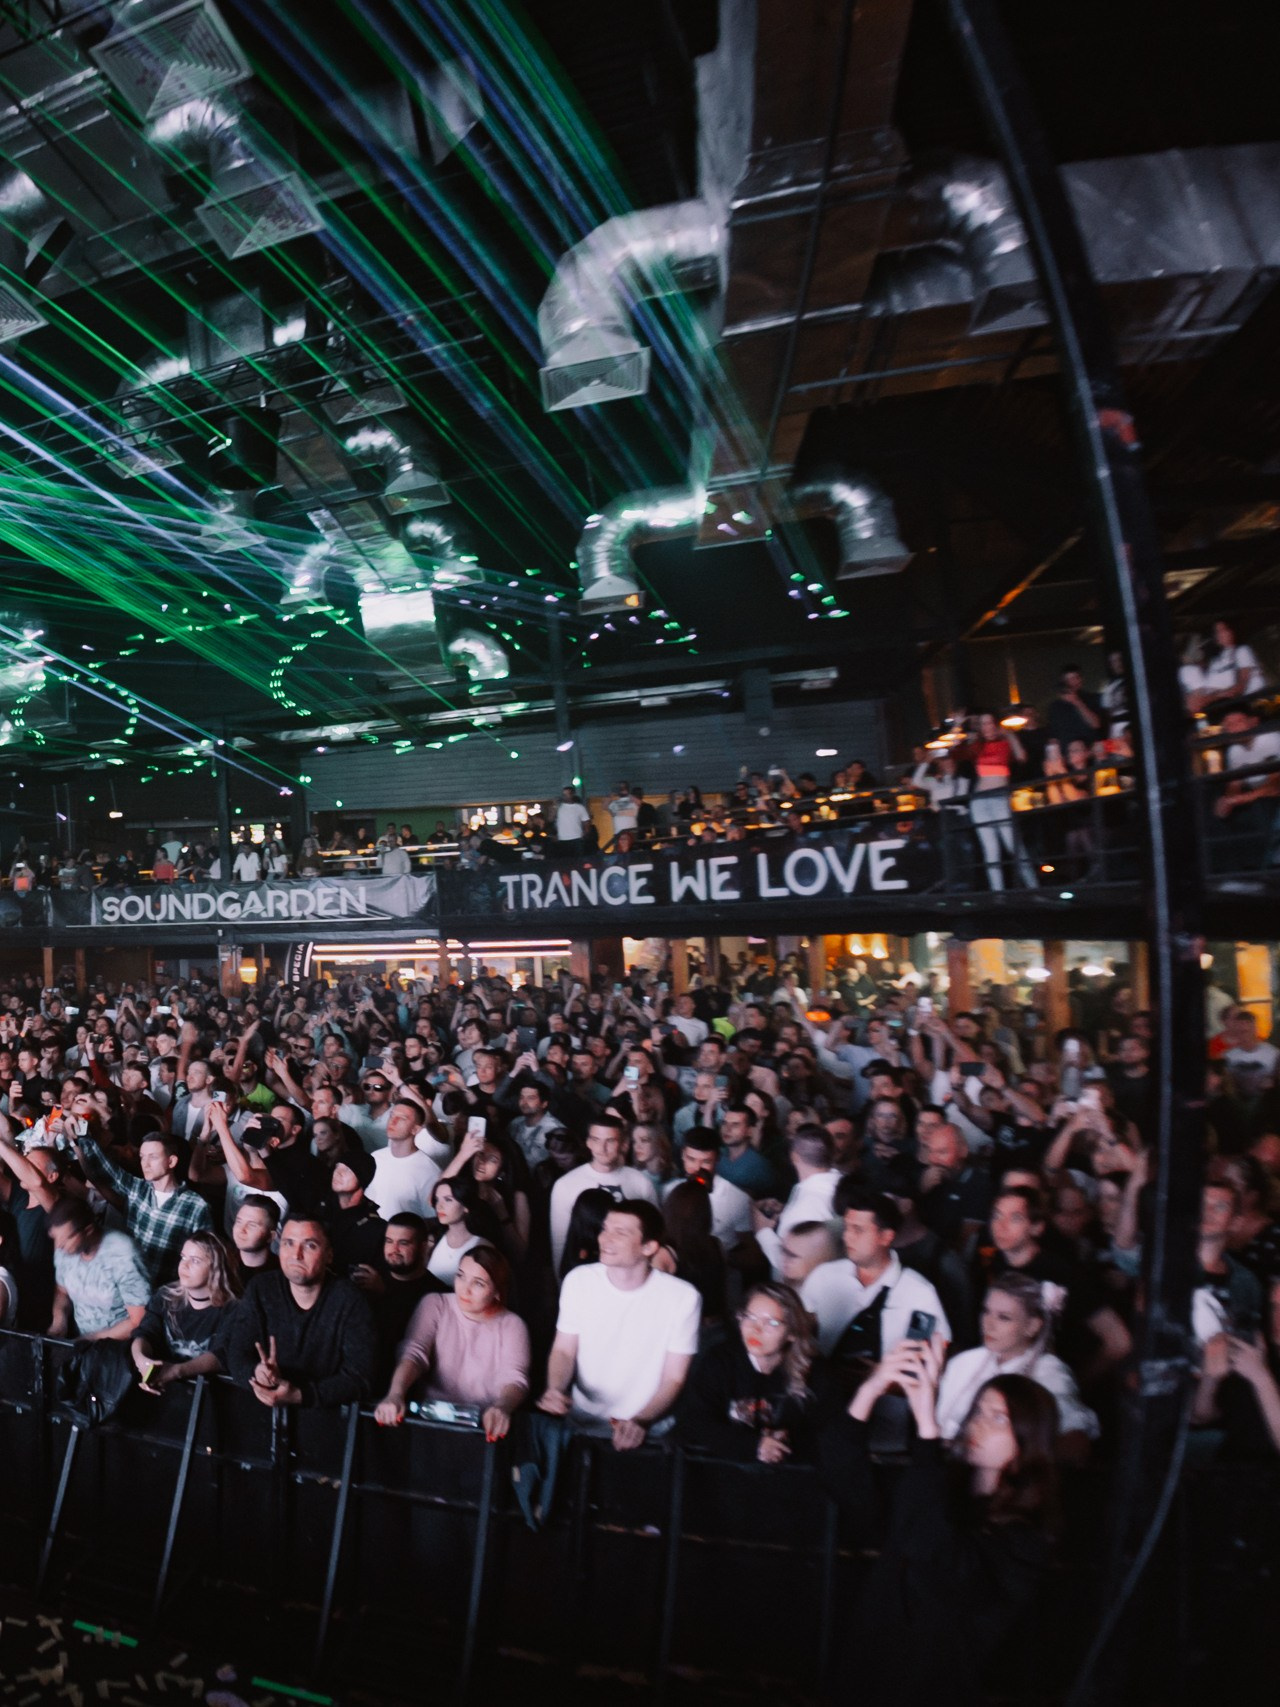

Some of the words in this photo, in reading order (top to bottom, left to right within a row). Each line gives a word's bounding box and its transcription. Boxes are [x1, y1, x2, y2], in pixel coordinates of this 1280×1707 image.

[499, 863, 655, 909] TRANCE
[670, 856, 741, 901] WE
[757, 838, 908, 897] LOVE
[102, 886, 368, 922] SOUNDGARDEN
